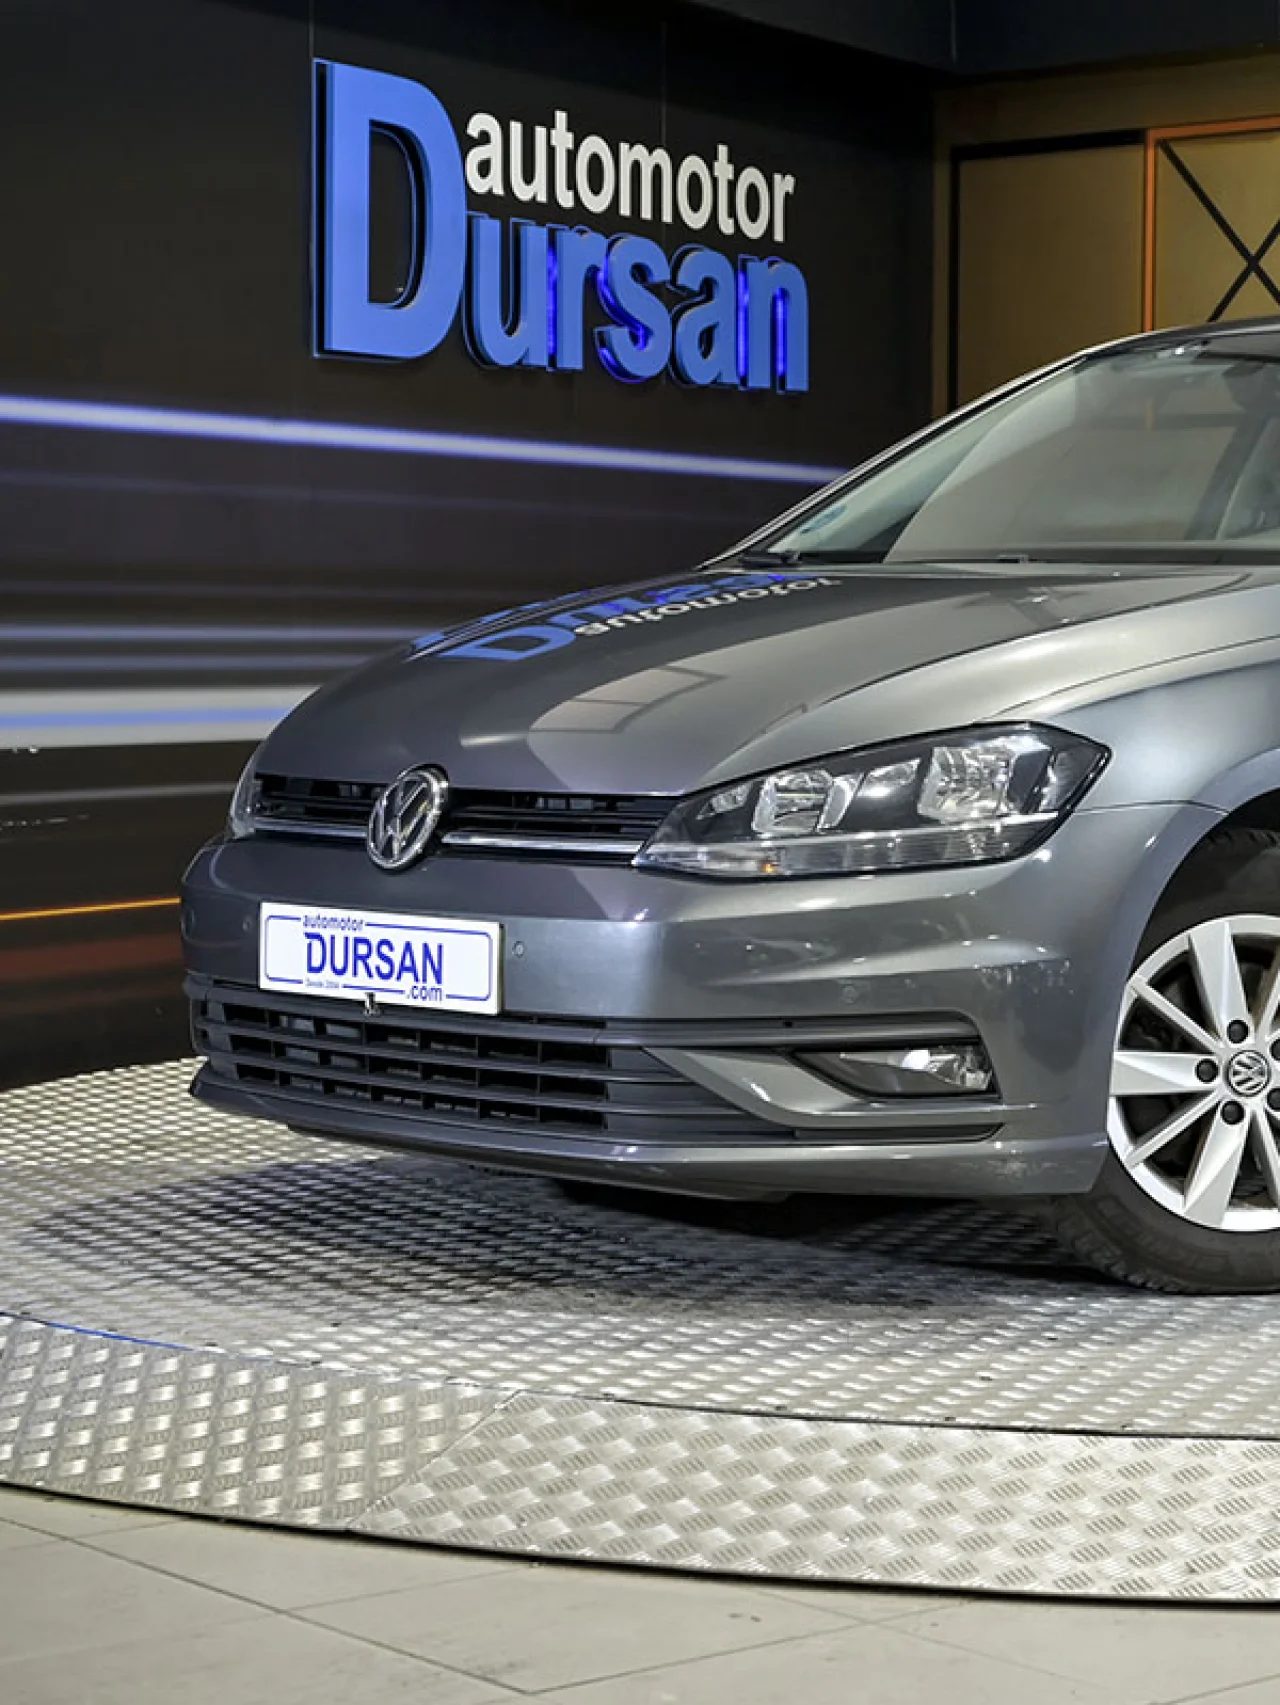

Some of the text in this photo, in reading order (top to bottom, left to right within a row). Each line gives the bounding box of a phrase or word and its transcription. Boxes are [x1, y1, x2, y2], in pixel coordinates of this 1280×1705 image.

[465, 110, 796, 242] automotor
[313, 57, 809, 393] Dursan
[303, 914, 364, 932] automotor
[303, 932, 443, 985] DURSAN
[407, 985, 442, 1001] .com
